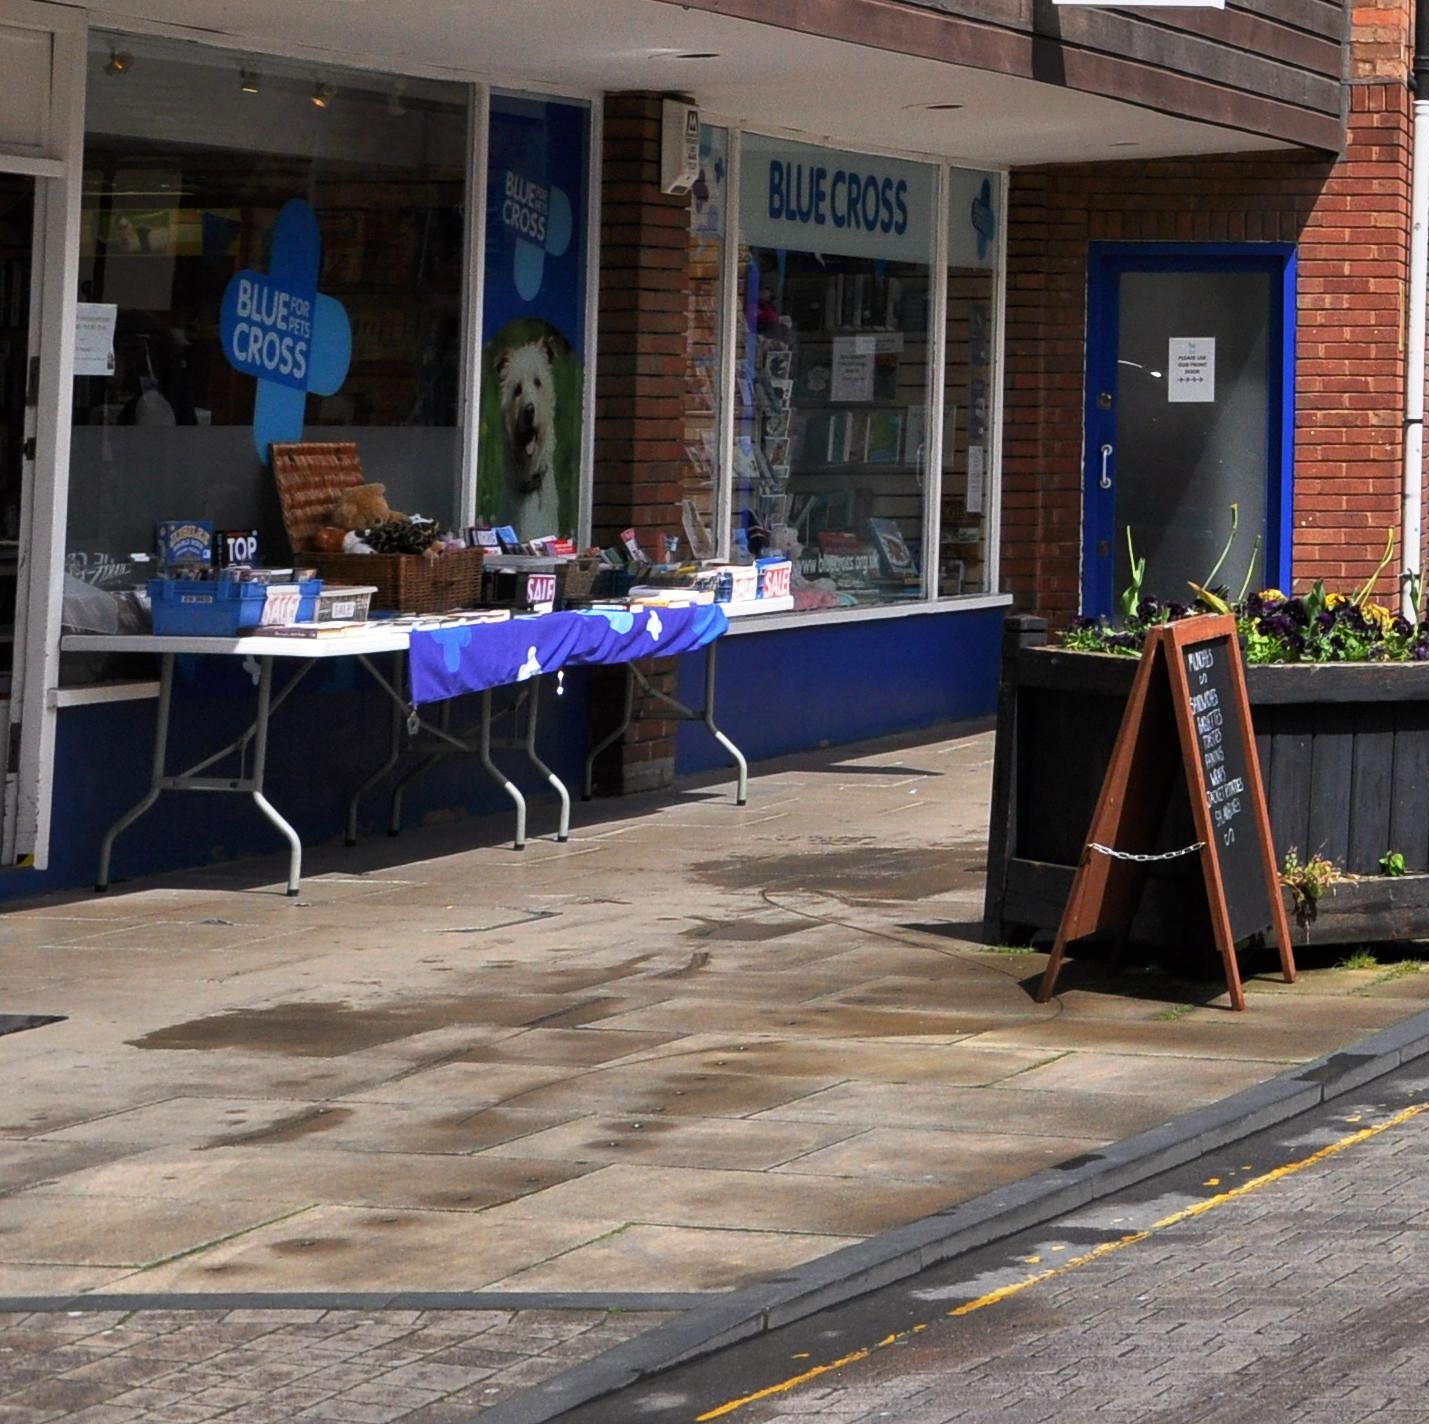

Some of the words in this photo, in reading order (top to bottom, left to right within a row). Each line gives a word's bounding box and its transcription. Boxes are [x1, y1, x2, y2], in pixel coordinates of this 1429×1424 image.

[505, 170, 537, 208] BLUE
[769, 160, 827, 225] BLUE
[830, 170, 907, 235] CROSS
[503, 199, 545, 241] CROSS
[237, 279, 290, 331] BLUE
[289, 297, 310, 317] FOR
[288, 316, 311, 339] PETS
[233, 322, 307, 379] CROSS
[226, 536, 258, 562] TOP
